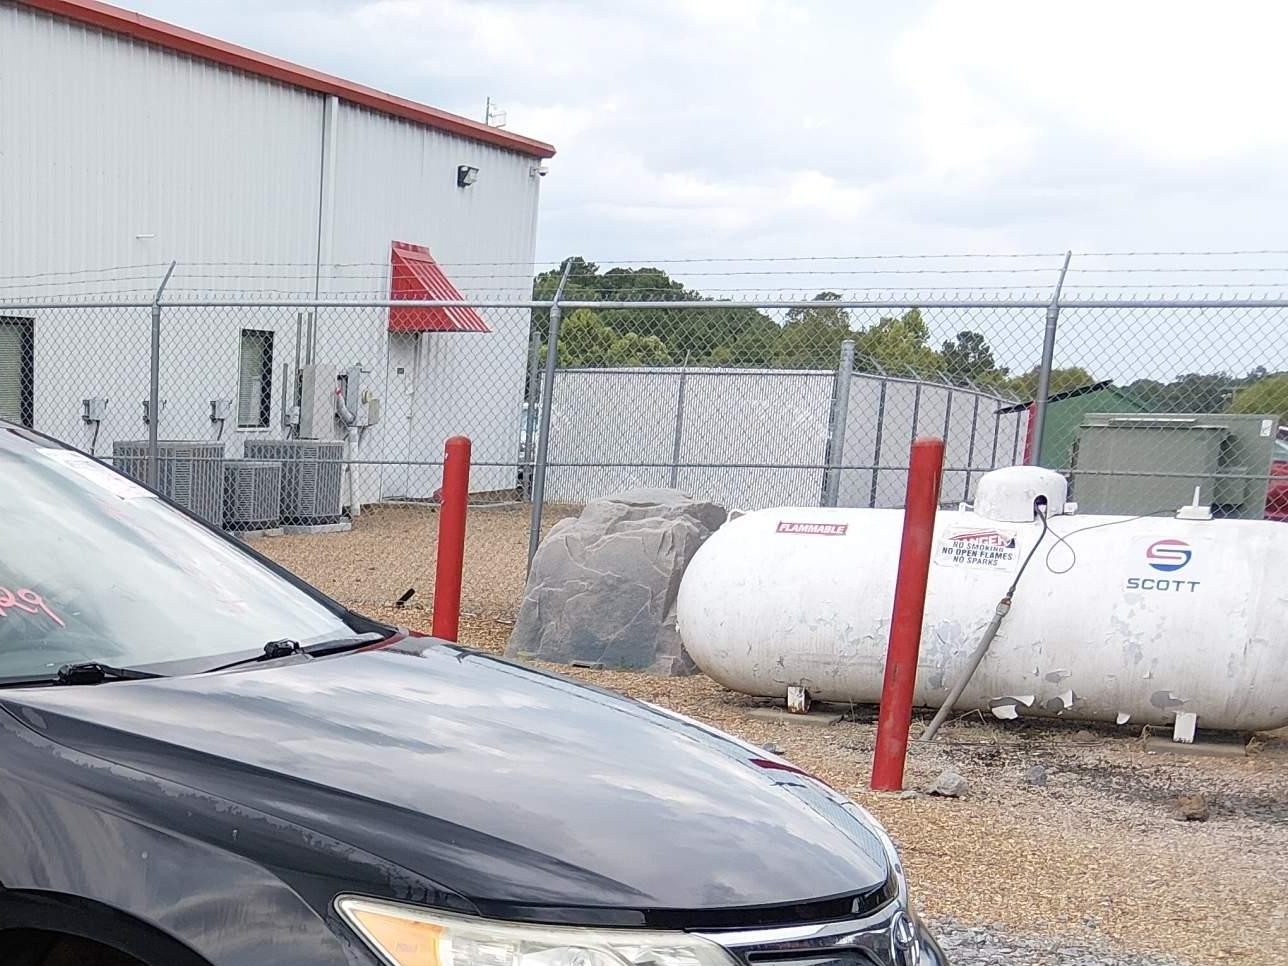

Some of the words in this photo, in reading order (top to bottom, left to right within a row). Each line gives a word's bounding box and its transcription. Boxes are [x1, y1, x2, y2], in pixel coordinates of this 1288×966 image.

[778, 522, 846, 534] FLAMMABLE
[952, 541, 965, 549] NO
[966, 542, 1004, 553] SMOKING
[942, 546, 953, 555] NO
[955, 548, 977, 557] OPEN
[979, 550, 1013, 561] FLAMES
[953, 555, 965, 564] NO
[966, 556, 999, 567] SPARKS
[1126, 577, 1201, 593] SCOTT
